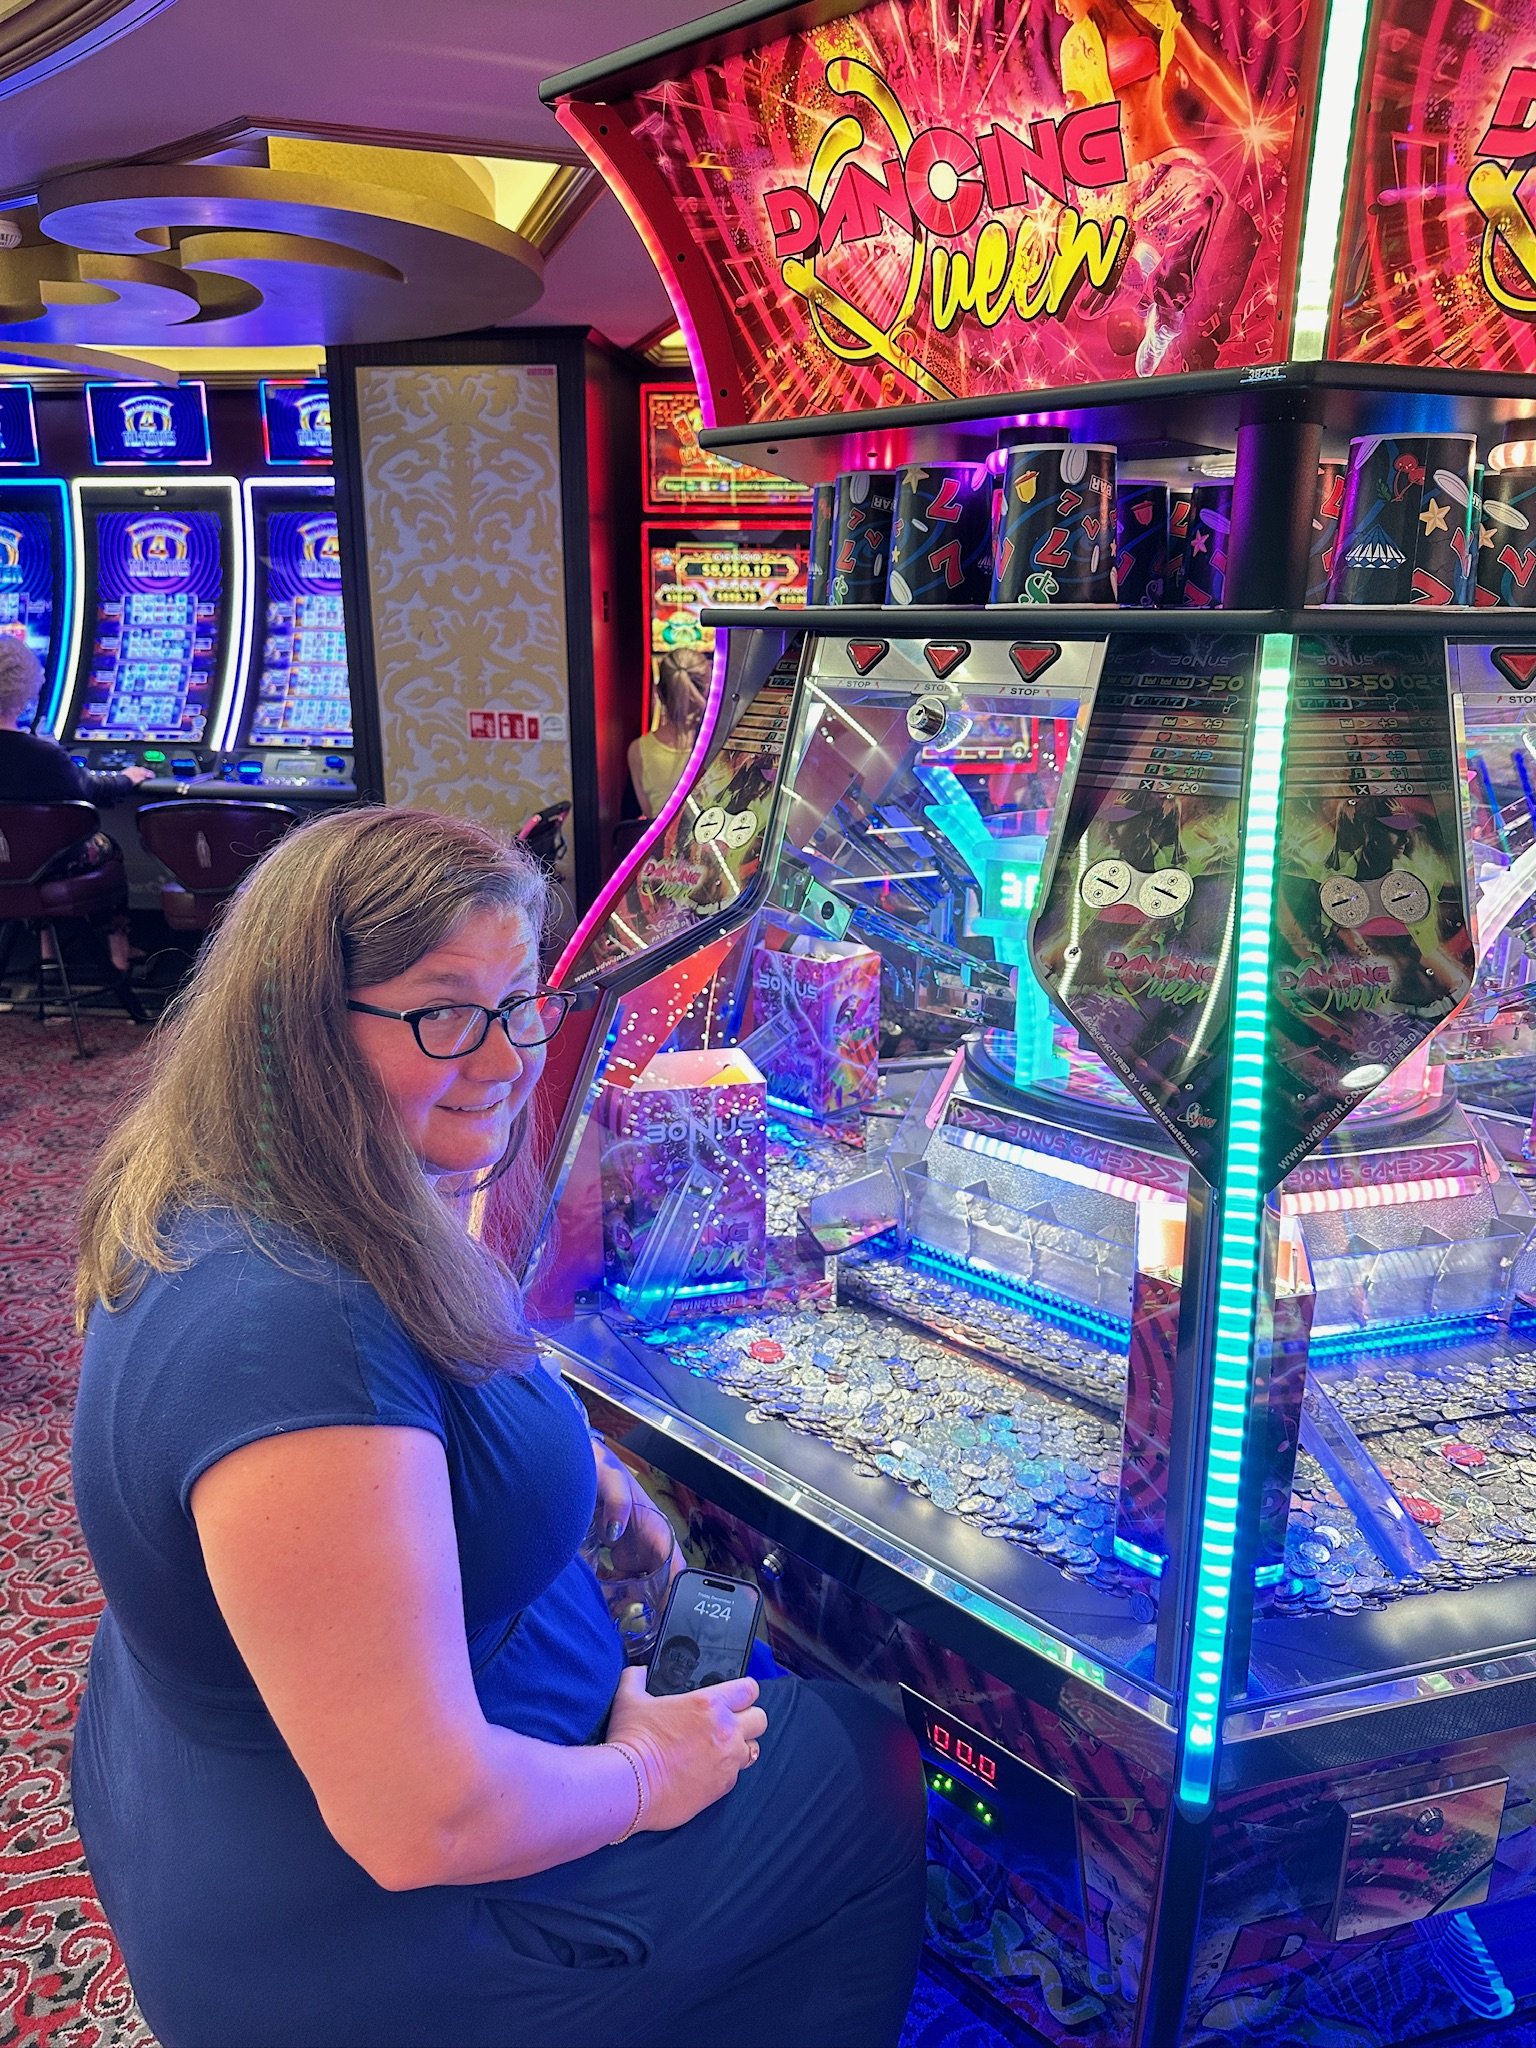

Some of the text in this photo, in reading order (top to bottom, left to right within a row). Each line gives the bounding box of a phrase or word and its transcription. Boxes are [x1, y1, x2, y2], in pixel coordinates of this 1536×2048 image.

[763, 100, 1128, 258] DANCING
[846, 680, 871, 688] STOP
[1010, 687, 1040, 697] STOP
[1210, 675, 1245, 691] 50
[1362, 674, 1394, 691] 50
[1509, 696, 1536, 704] STO
[1105, 951, 1217, 983] DANCING
[1279, 963, 1392, 990] DANCING
[759, 972, 819, 1000] BONUS
[1128, 1069, 1140, 1084] BY
[1138, 1083, 1156, 1105] VdW
[1153, 1102, 1199, 1157] International
[646, 1115, 758, 1144] BONUS
[1005, 1122, 1124, 1169] BONUS GAME
[1287, 1158, 1413, 1187] BONUS GAME
[694, 1600, 732, 1622] 4:24
[934, 1724, 996, 1780] 00.0
